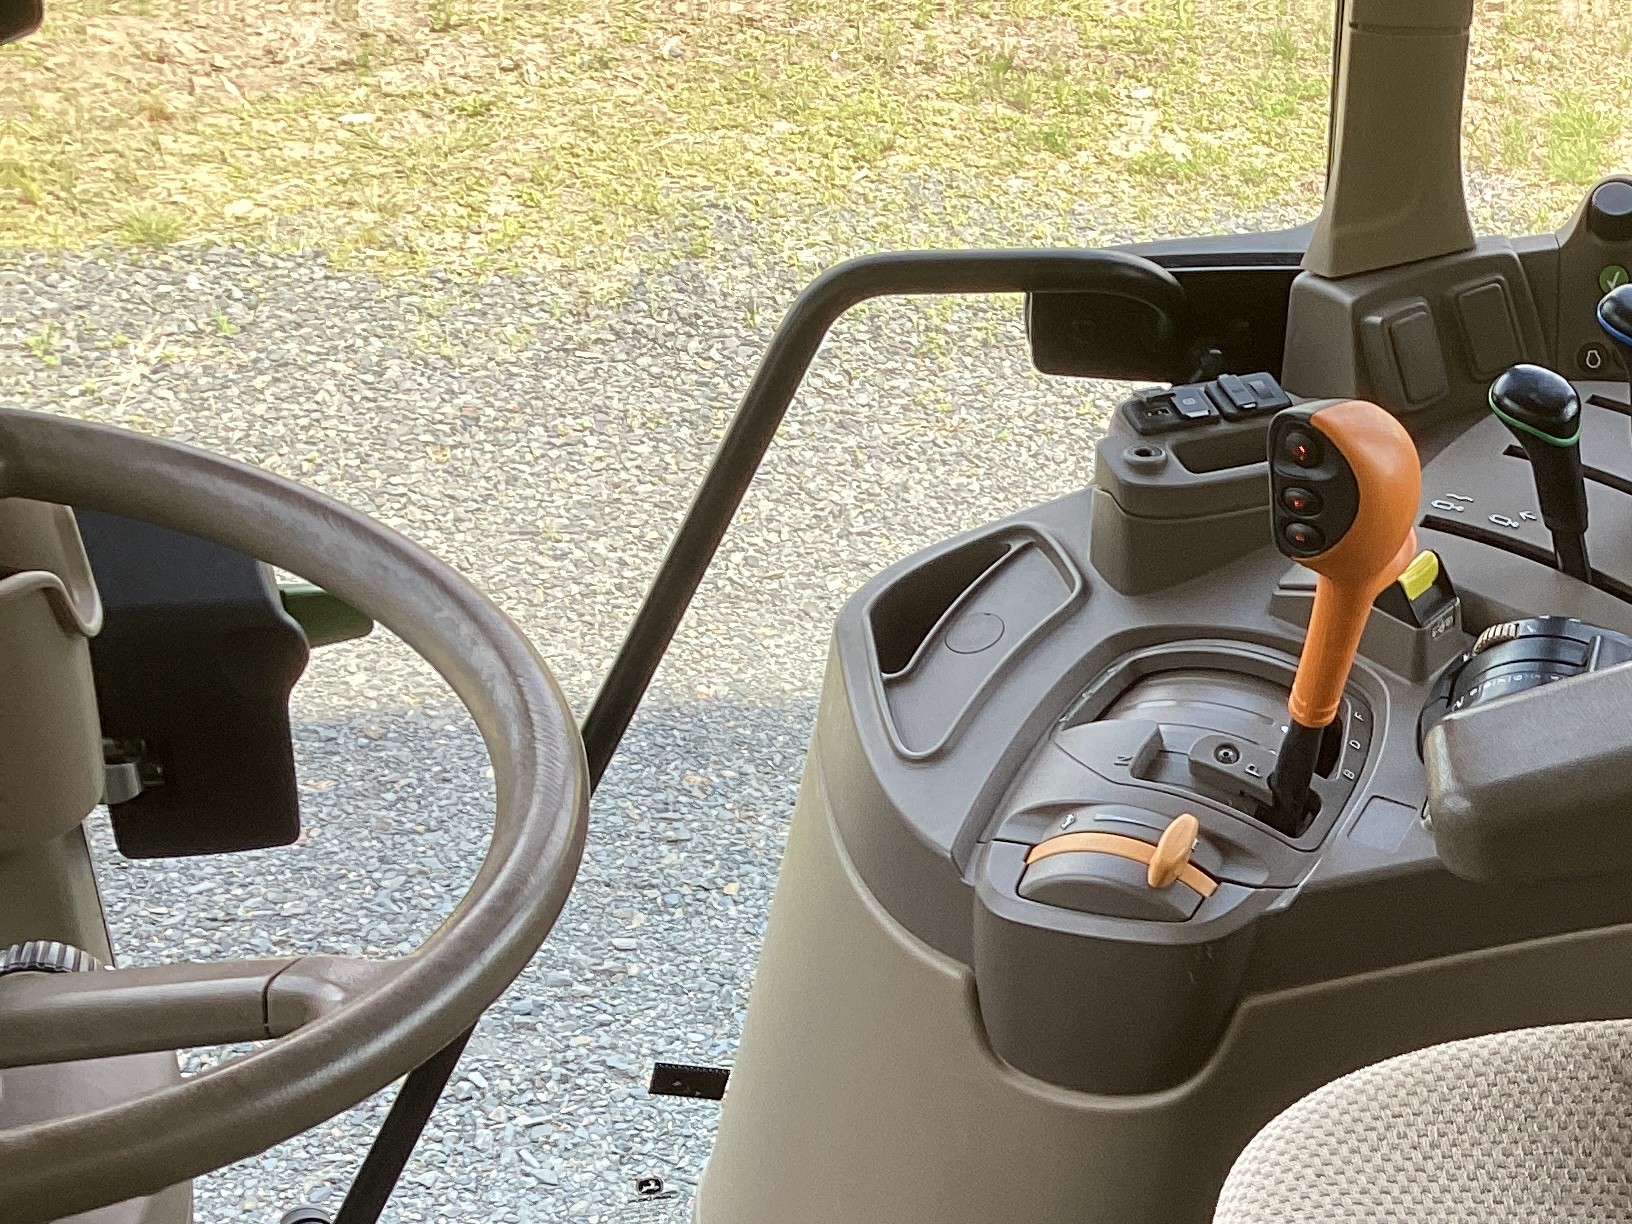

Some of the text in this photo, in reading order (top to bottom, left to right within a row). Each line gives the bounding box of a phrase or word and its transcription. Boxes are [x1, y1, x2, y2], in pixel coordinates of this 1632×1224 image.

[1353, 710, 1364, 722] F
[1348, 739, 1361, 750] D
[1244, 763, 1262, 778] P
[1342, 768, 1355, 780] B
